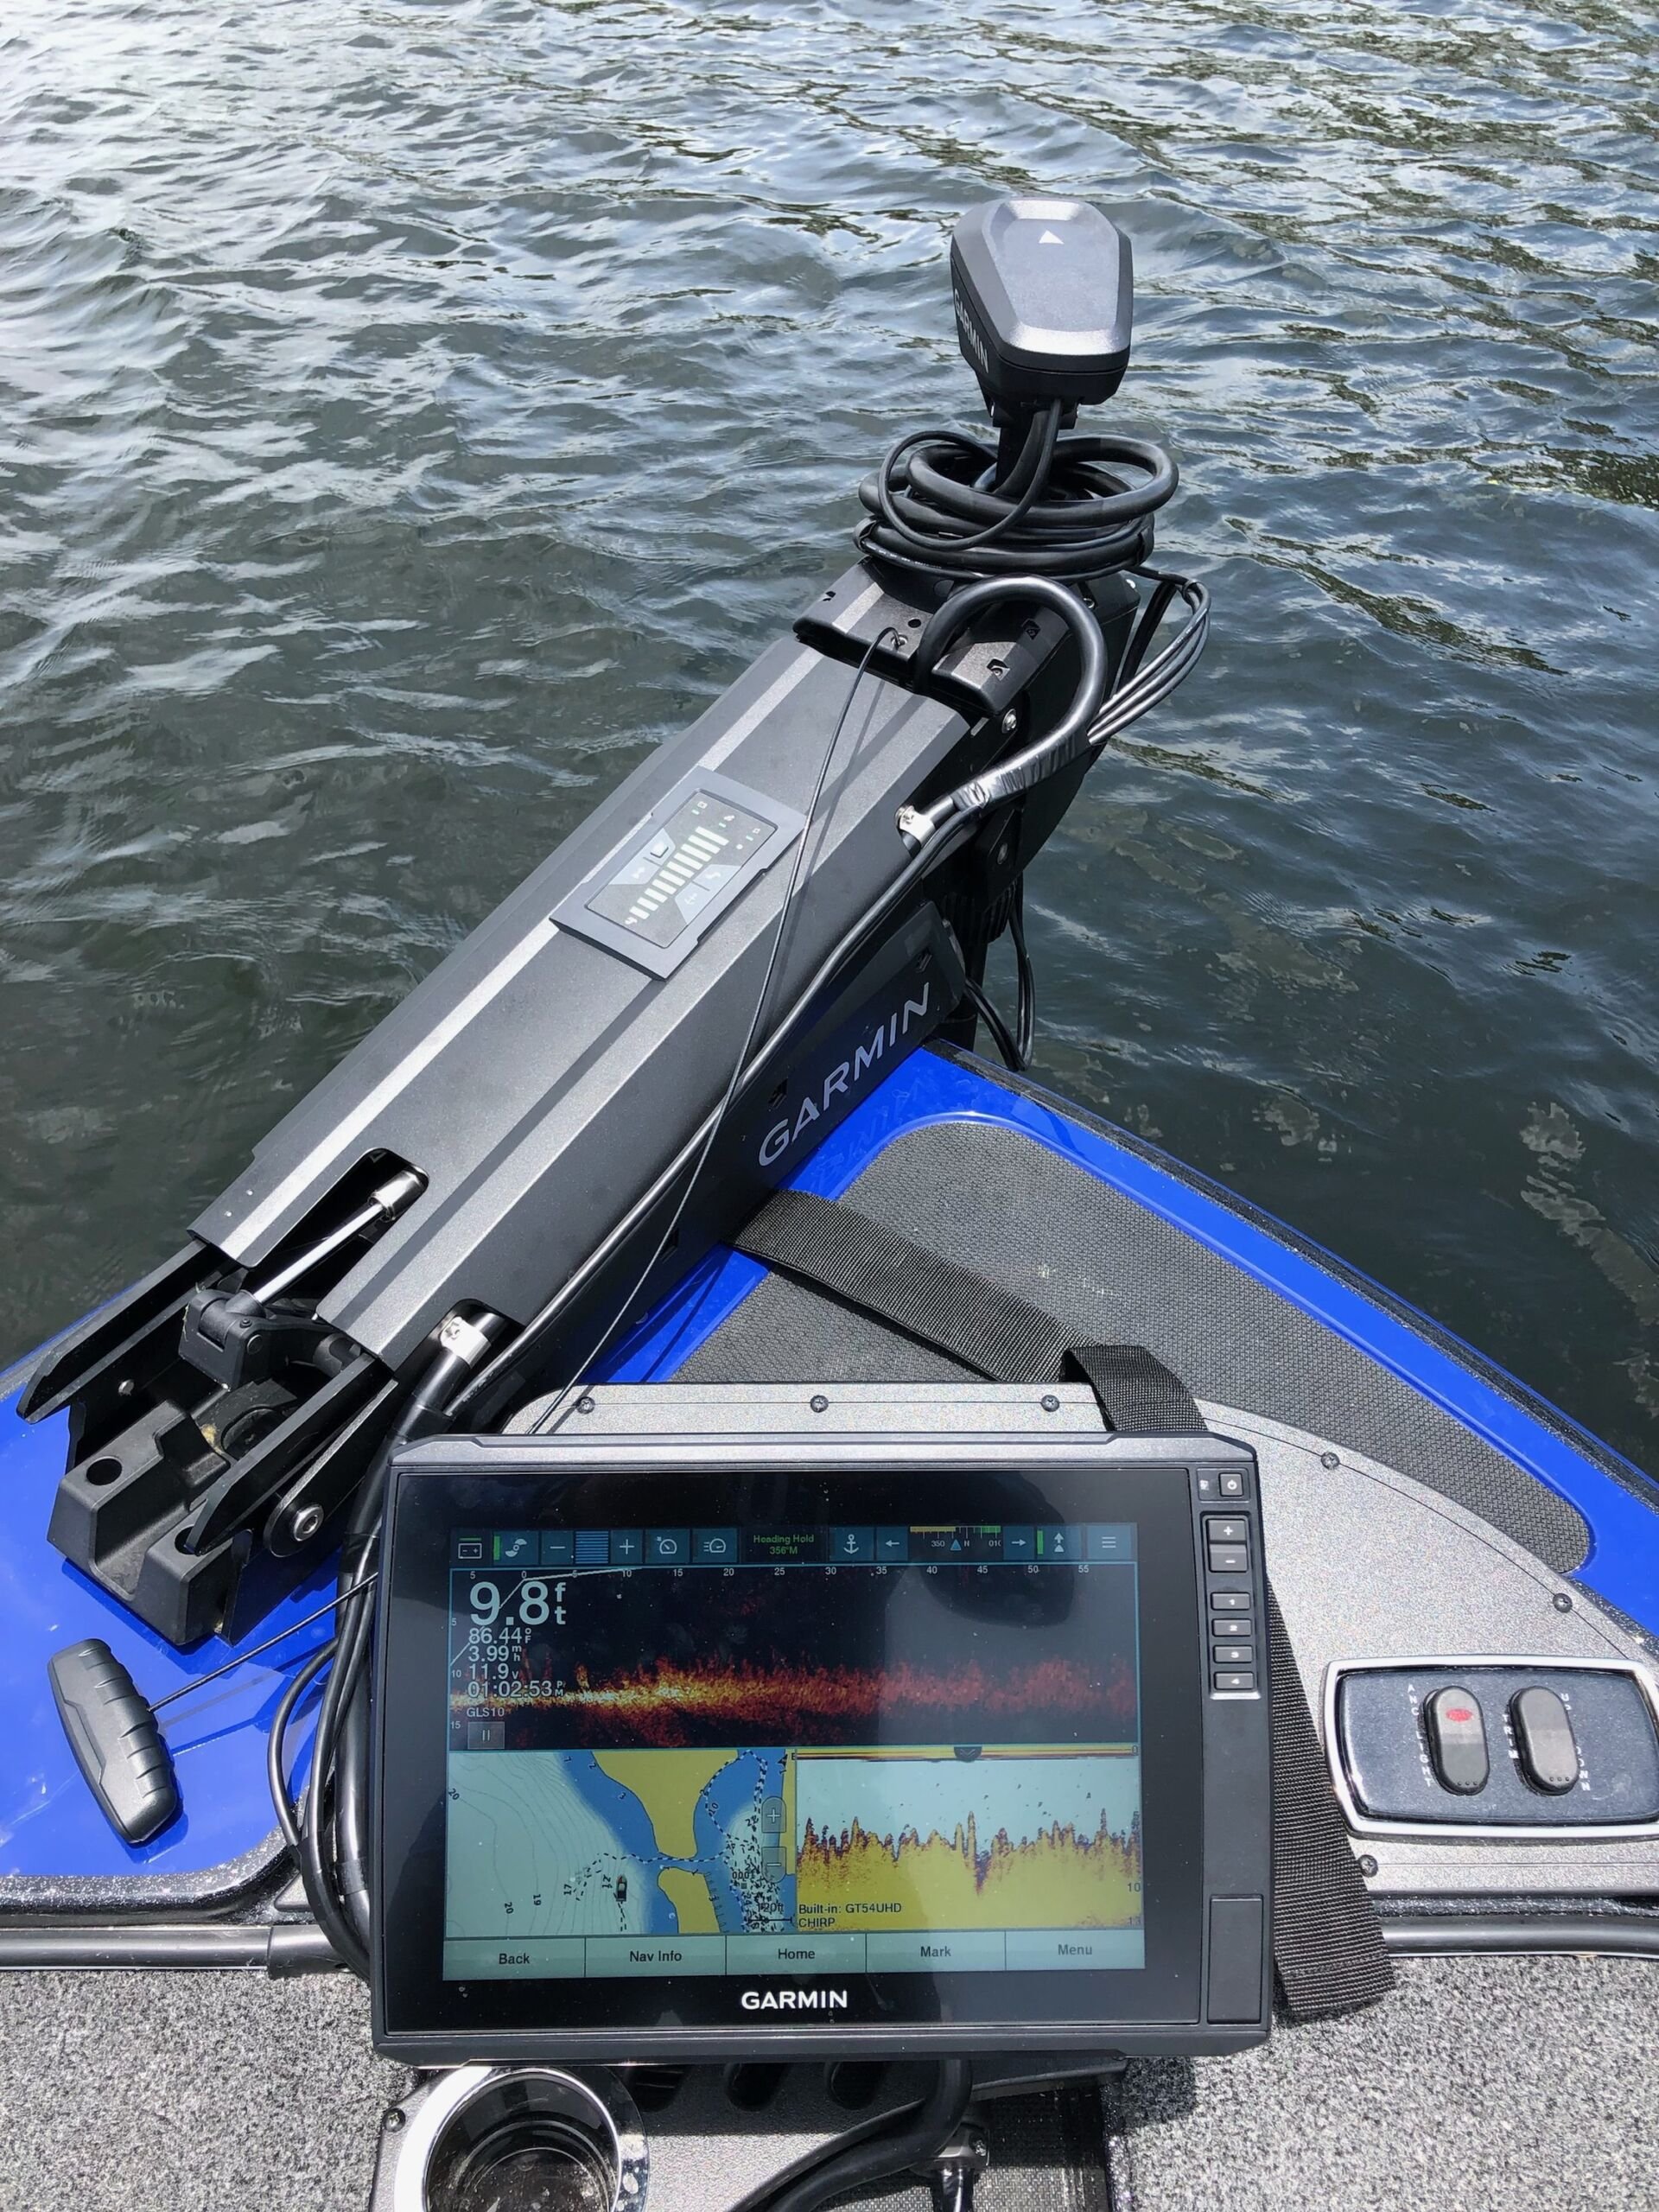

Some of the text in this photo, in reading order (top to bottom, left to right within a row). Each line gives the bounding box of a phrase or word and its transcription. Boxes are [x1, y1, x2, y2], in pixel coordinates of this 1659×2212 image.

[954, 288, 989, 374] GARMIN
[759, 982, 930, 1166] GARMIN
[753, 1534, 815, 1546] Heading Hold
[469, 1570, 476, 1580] 5
[521, 1570, 527, 1580] 0
[621, 1568, 632, 1578] 10
[672, 1568, 683, 1578] 15
[723, 1567, 734, 1577] 20
[774, 1567, 785, 1576] 25
[825, 1567, 837, 1576] 30
[875, 1566, 887, 1576] 35
[926, 1565, 938, 1575] 40
[976, 1565, 988, 1575] 45
[1027, 1565, 1039, 1574] 50
[1077, 1564, 1090, 1574] 55
[469, 1581, 550, 1625] 9.8
[451, 1618, 457, 1626] 5
[468, 1627, 522, 1644] 86.44
[467, 1645, 510, 1662] 3.99
[451, 1669, 461, 1678] 10
[469, 1663, 509, 1680] 11.9
[467, 1680, 553, 1698] 01:02:53
[467, 1707, 505, 1718] GLS10
[450, 1720, 461, 1729] 15
[1415, 1730, 1433, 1788] LIGHT
[448, 1788, 461, 1801] 20
[563, 1884, 572, 1896] 17
[1128, 1882, 1141, 1892] 10
[532, 1893, 542, 1906] 19
[504, 1902, 514, 1915] 20
[798, 1903, 902, 1915] Built-in: GT54UHD
[798, 1916, 836, 1929] CHIRP
[629, 1949, 683, 1962] Nav Info
[778, 1948, 816, 1961] Home
[919, 1945, 951, 1958] Mark
[1057, 1943, 1093, 1956] Menu
[498, 1952, 531, 1965] Back
[741, 1990, 848, 2010] GARMIN
